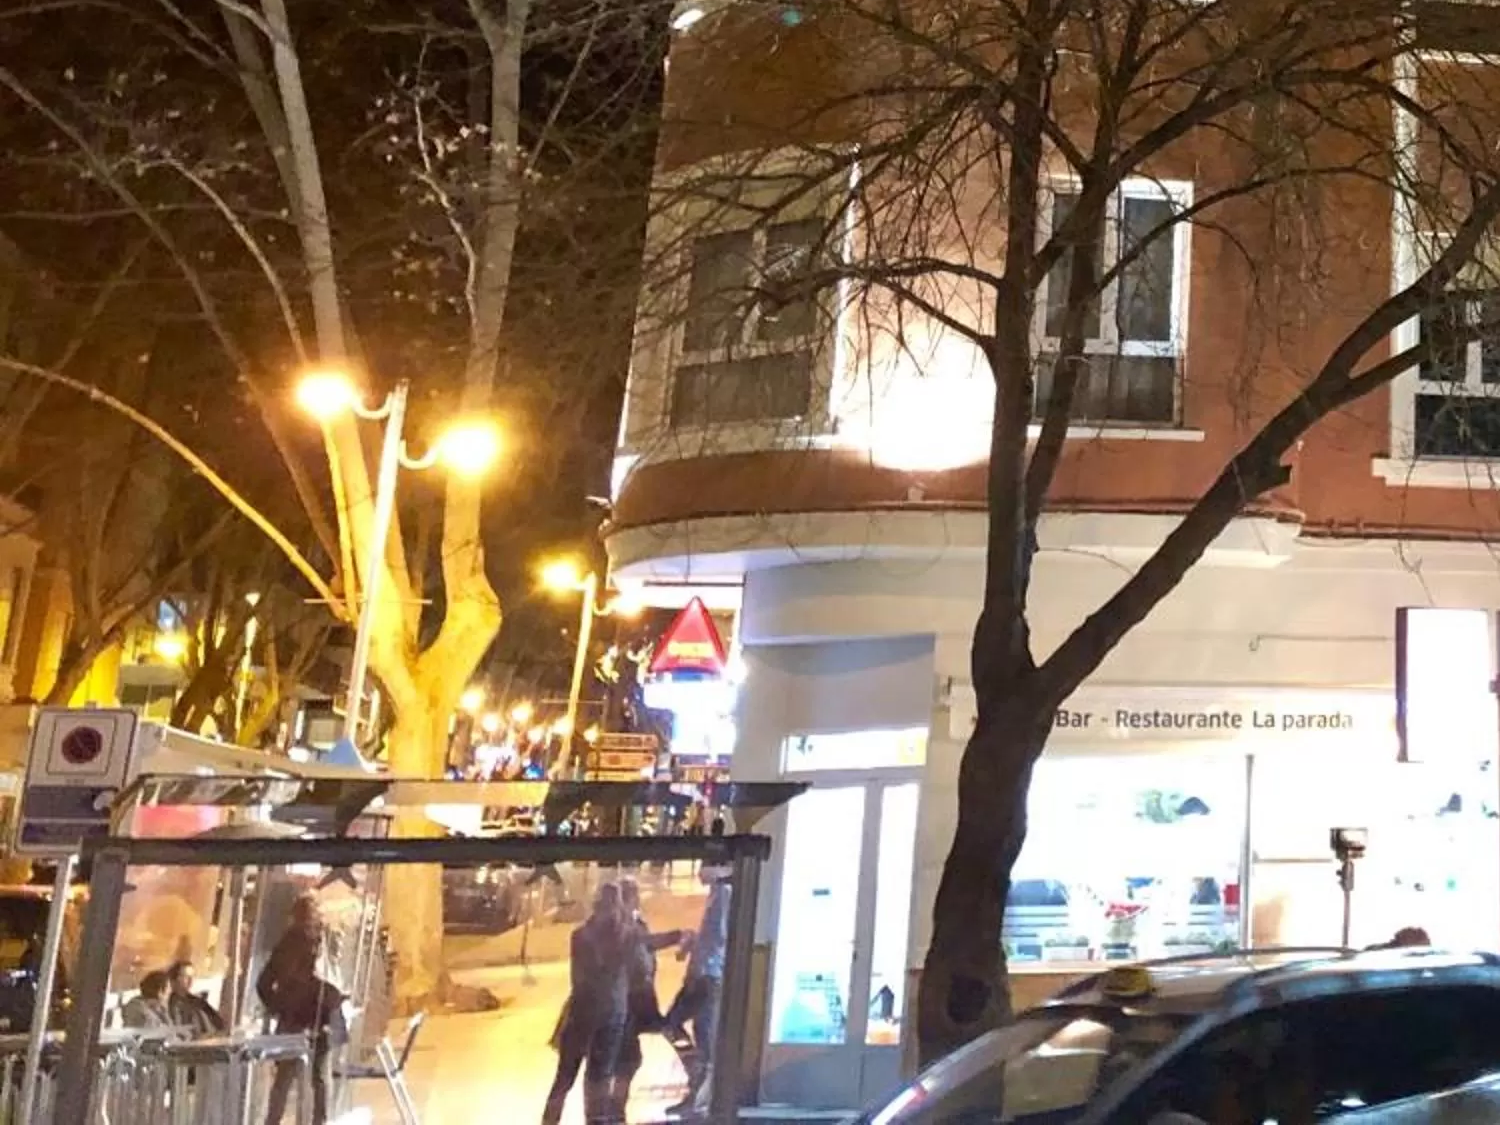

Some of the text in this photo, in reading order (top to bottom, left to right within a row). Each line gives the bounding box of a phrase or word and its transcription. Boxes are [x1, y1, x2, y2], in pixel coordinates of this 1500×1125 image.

[1055, 710, 1092, 728] Bar
[1115, 710, 1243, 728] Restaurante
[1252, 710, 1276, 728] La
[1282, 711, 1353, 731] parada
